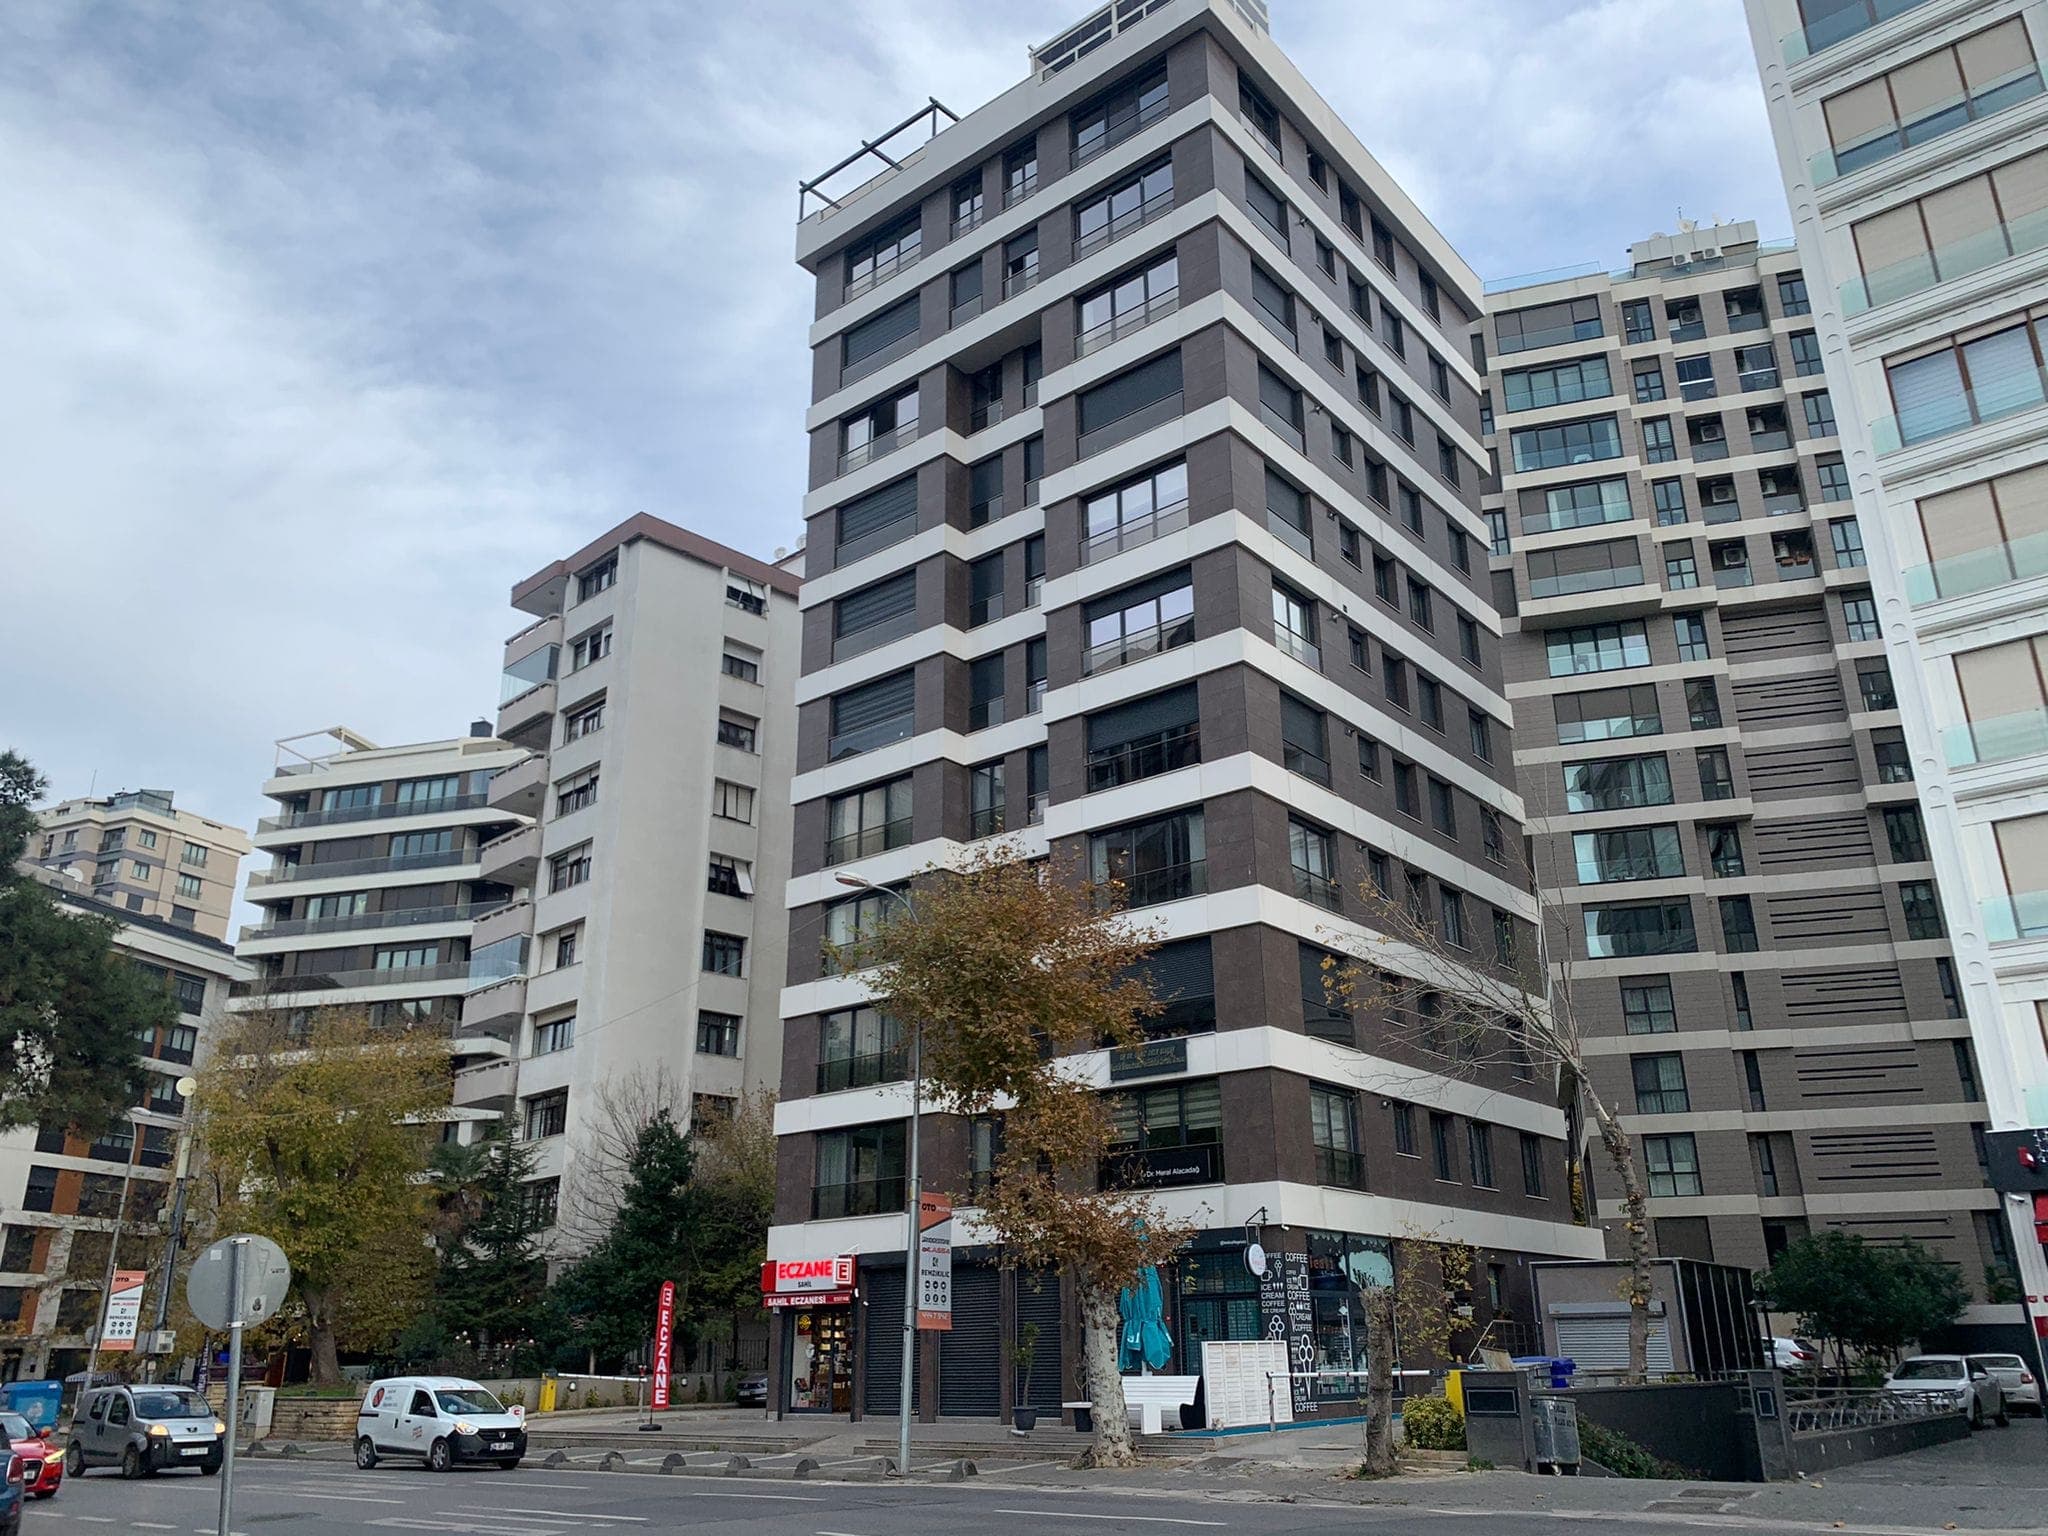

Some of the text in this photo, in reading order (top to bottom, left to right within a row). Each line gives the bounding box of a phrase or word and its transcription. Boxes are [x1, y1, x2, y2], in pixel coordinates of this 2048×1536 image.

[921, 1203, 936, 1212] OTO
[1285, 1252, 1308, 1263] COFFEE
[778, 1260, 833, 1279] ECZANE
[839, 1264, 848, 1279] E
[1261, 1283, 1272, 1291] ICE
[767, 1297, 789, 1307] SAHİL
[790, 1294, 827, 1306] ECZANESİ
[1261, 1292, 1285, 1300] CREAM
[1287, 1290, 1310, 1301] COFFEE
[1261, 1300, 1285, 1308] COFFEE
[1296, 1312, 1313, 1321] CREAM
[1295, 1323, 1313, 1332] COFFEE
[655, 1310, 669, 1405] ECZANE
[1295, 1401, 1319, 1412] COFFEE
